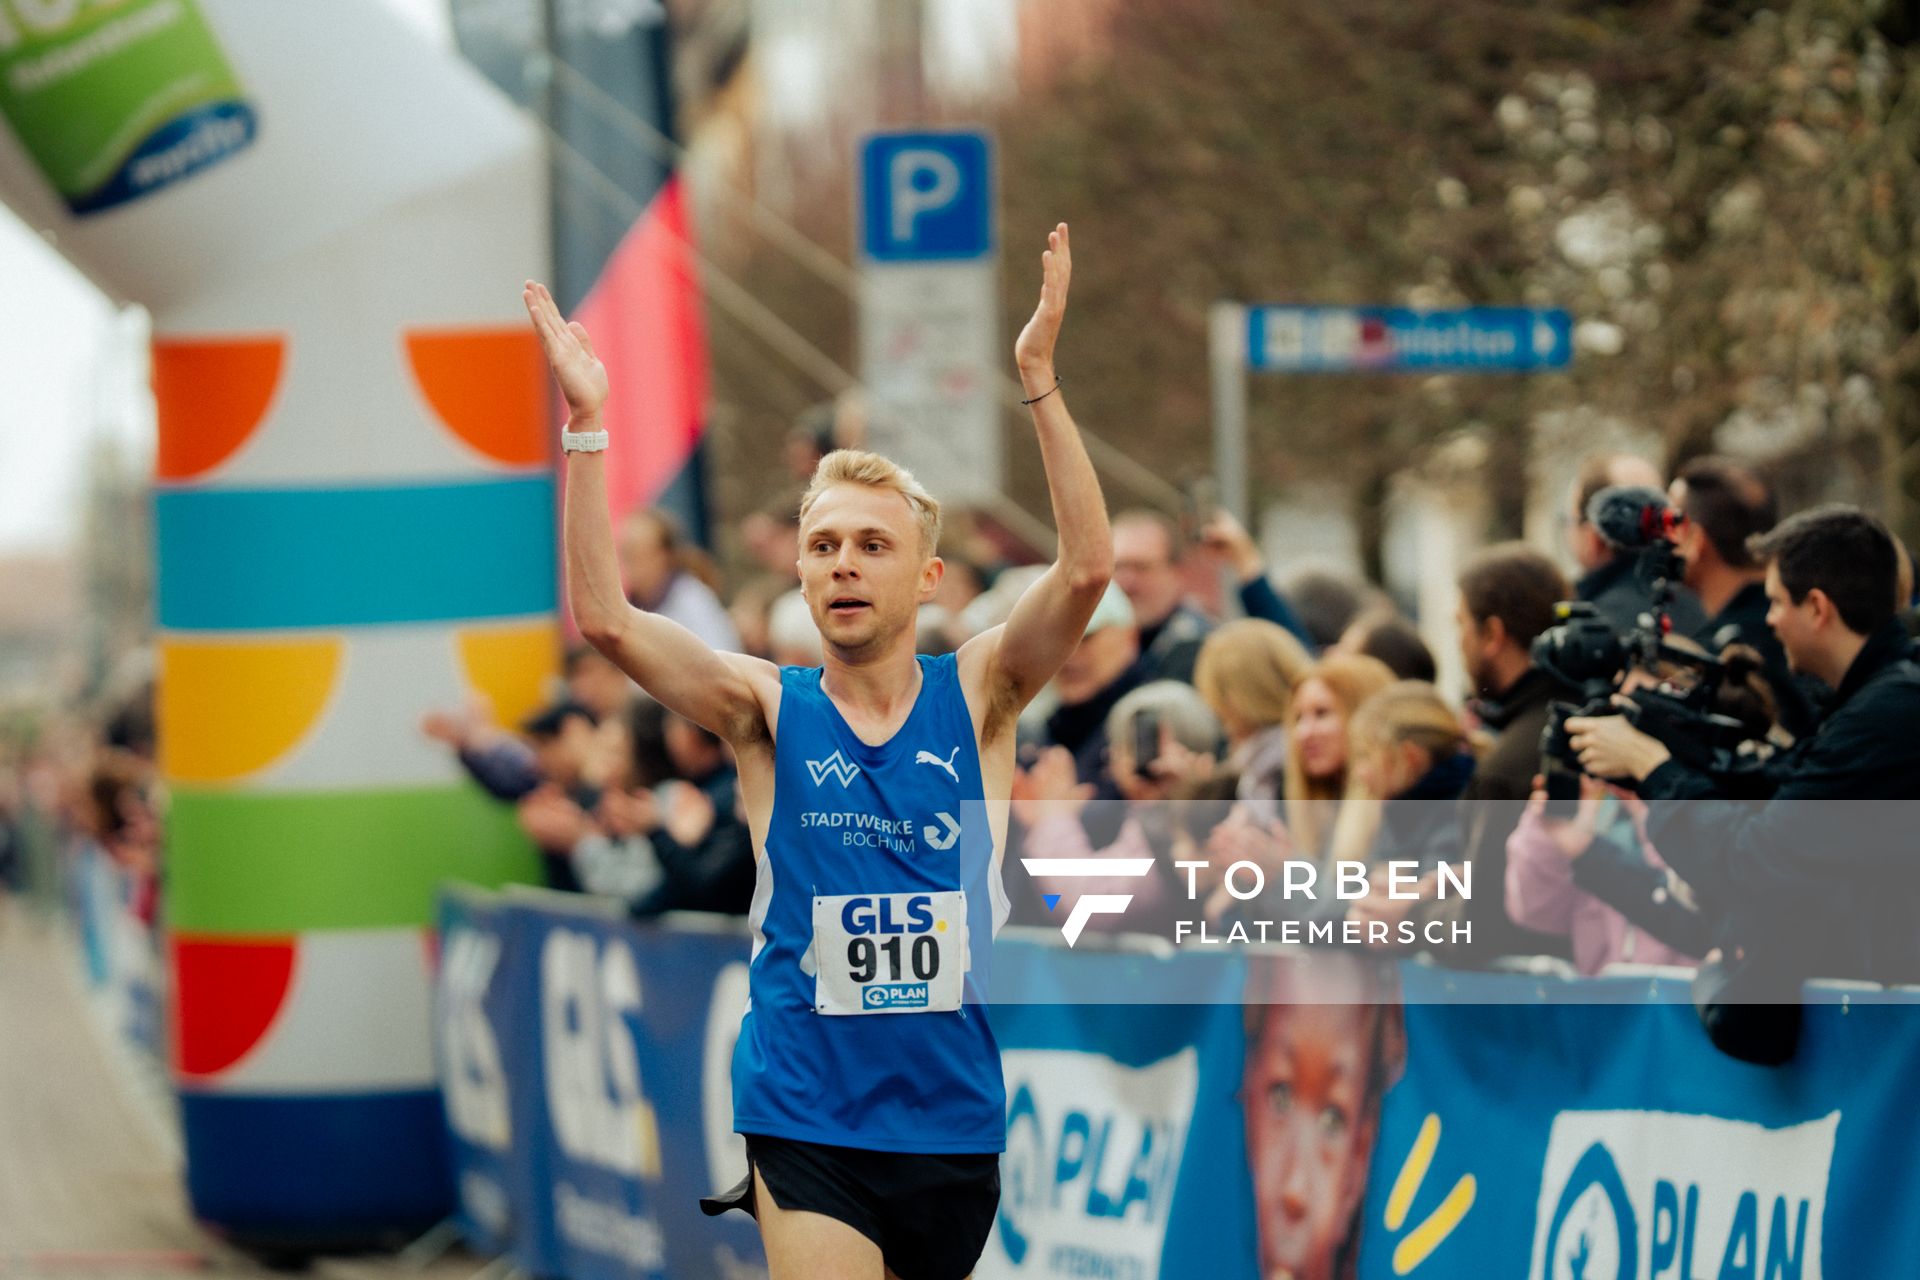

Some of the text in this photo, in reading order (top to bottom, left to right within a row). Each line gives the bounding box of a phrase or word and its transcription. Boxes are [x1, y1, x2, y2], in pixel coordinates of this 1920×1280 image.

[891, 150, 959, 241] P
[801, 812, 912, 835] STADTWERKE
[843, 831, 915, 853] BOCHUM
[847, 935, 940, 982] 910
[890, 986, 926, 999] PLAN
